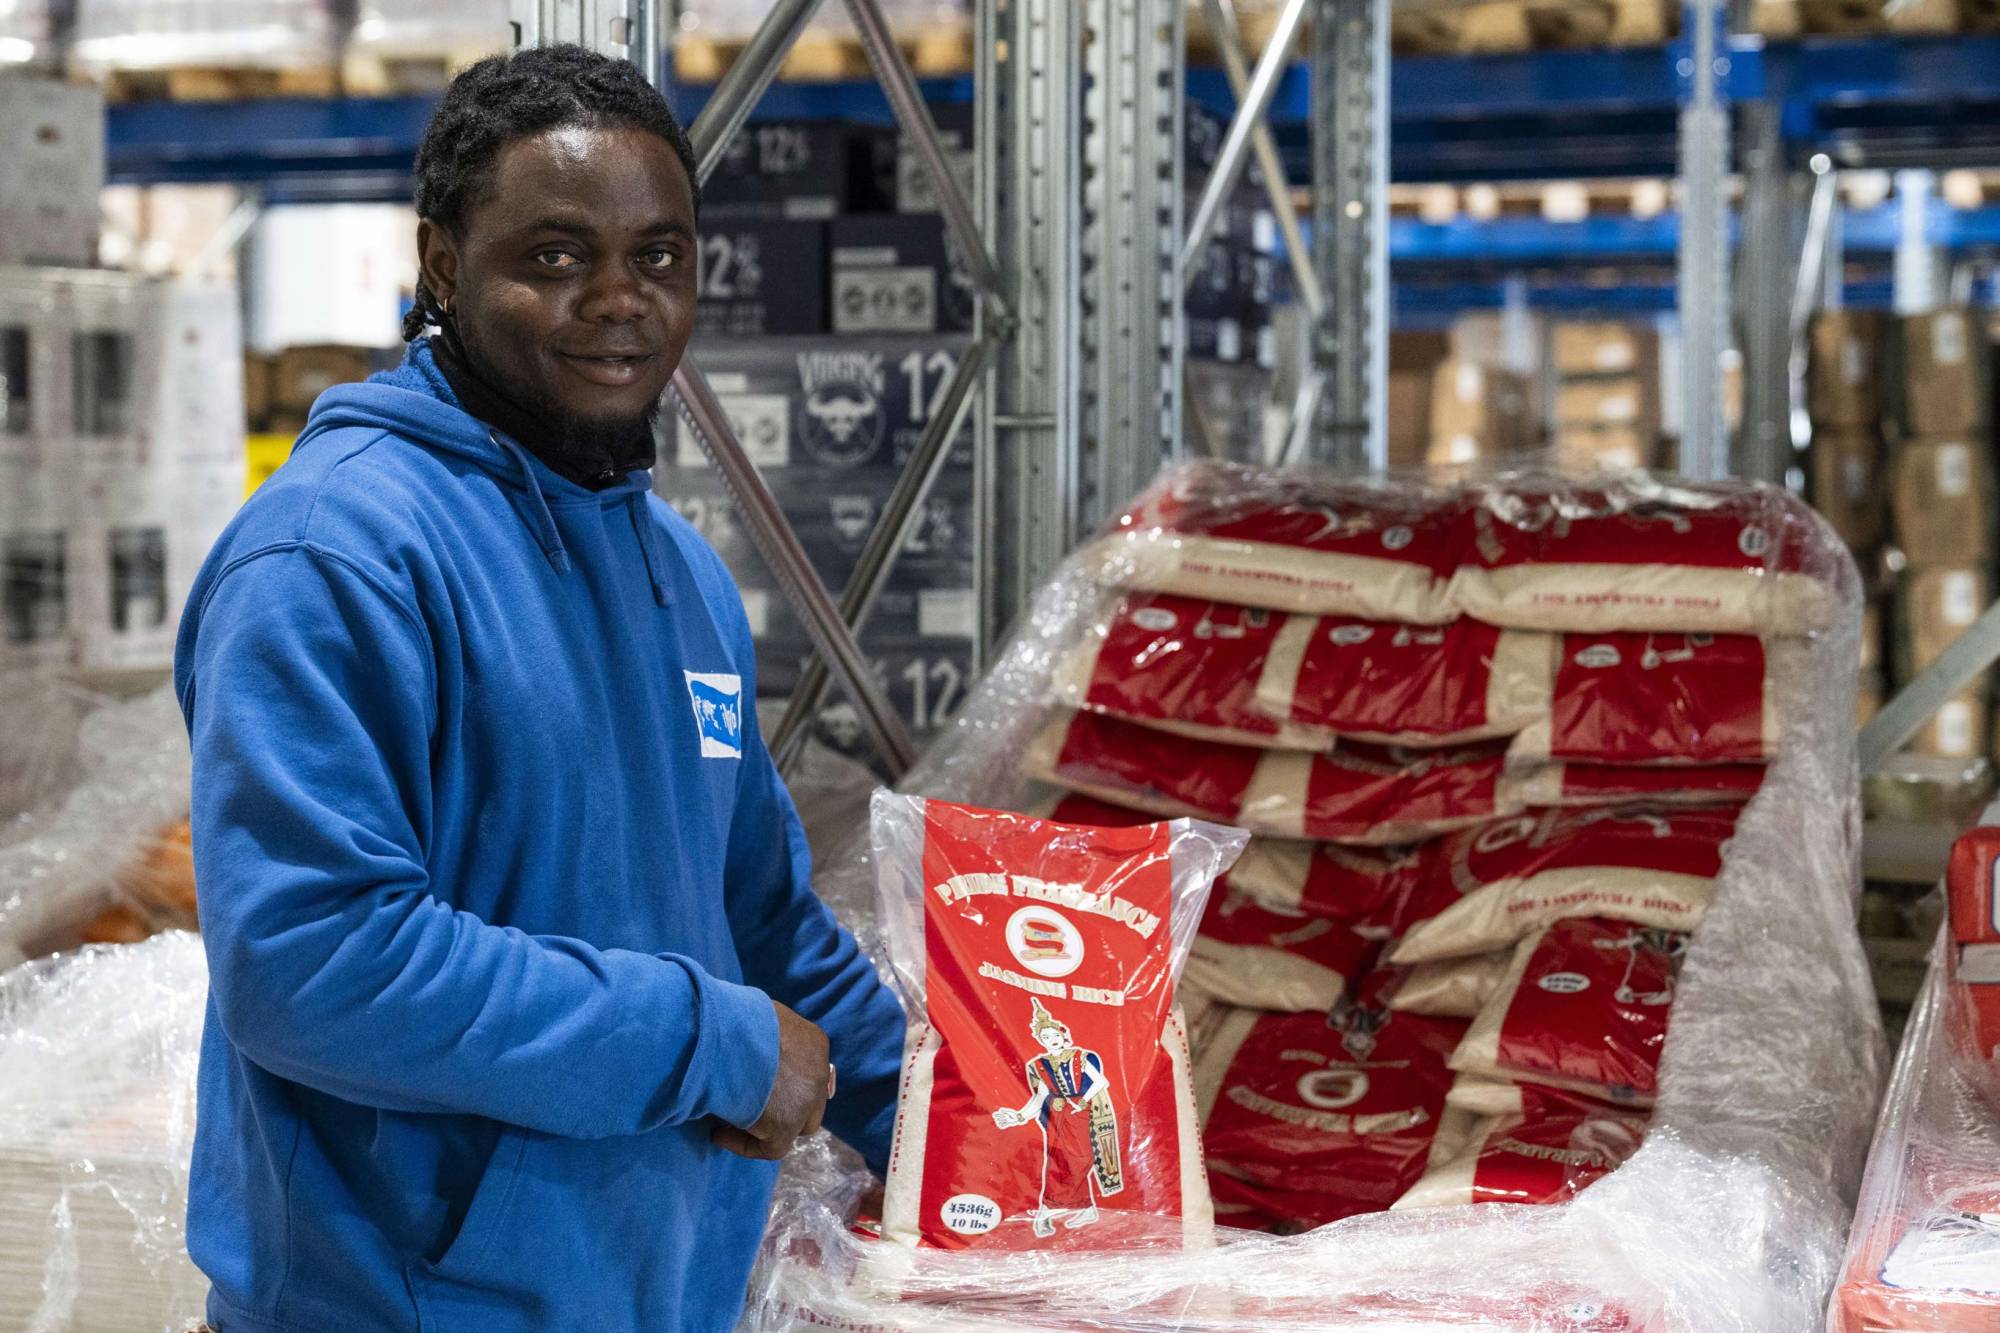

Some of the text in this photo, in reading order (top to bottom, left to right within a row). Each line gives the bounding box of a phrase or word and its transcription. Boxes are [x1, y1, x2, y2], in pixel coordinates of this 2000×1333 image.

[977, 961, 1125, 1006] JASMINE RICE
[949, 1202, 994, 1219] 4536g
[952, 1218, 988, 1230] 10 lbs
